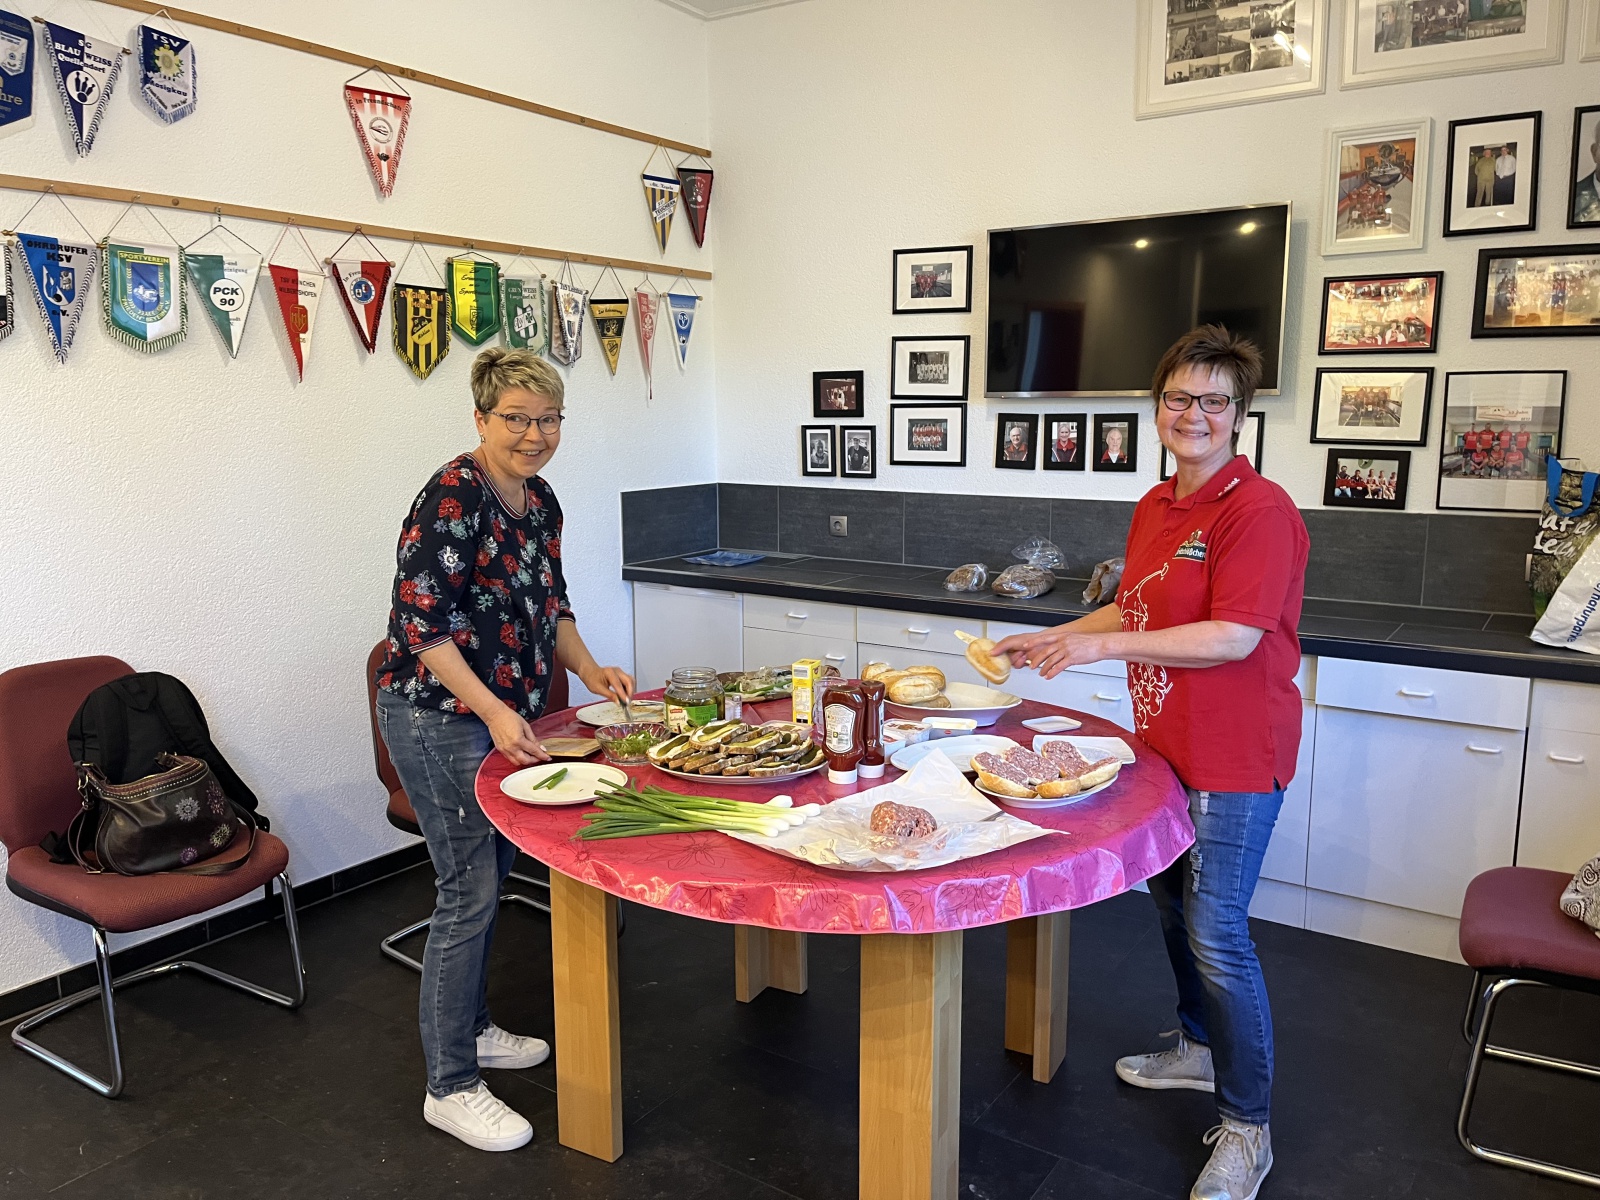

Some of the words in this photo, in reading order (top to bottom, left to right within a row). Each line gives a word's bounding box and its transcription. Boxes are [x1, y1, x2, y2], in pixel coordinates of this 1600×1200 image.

[151, 32, 180, 48] TSV
[54, 42, 81, 56] BLAU
[84, 52, 112, 67] WEISS
[26, 240, 88, 256] OHRDRUFER
[46, 252, 72, 263] KSV
[213, 287, 240, 296] PCK
[220, 298, 236, 306] 90
